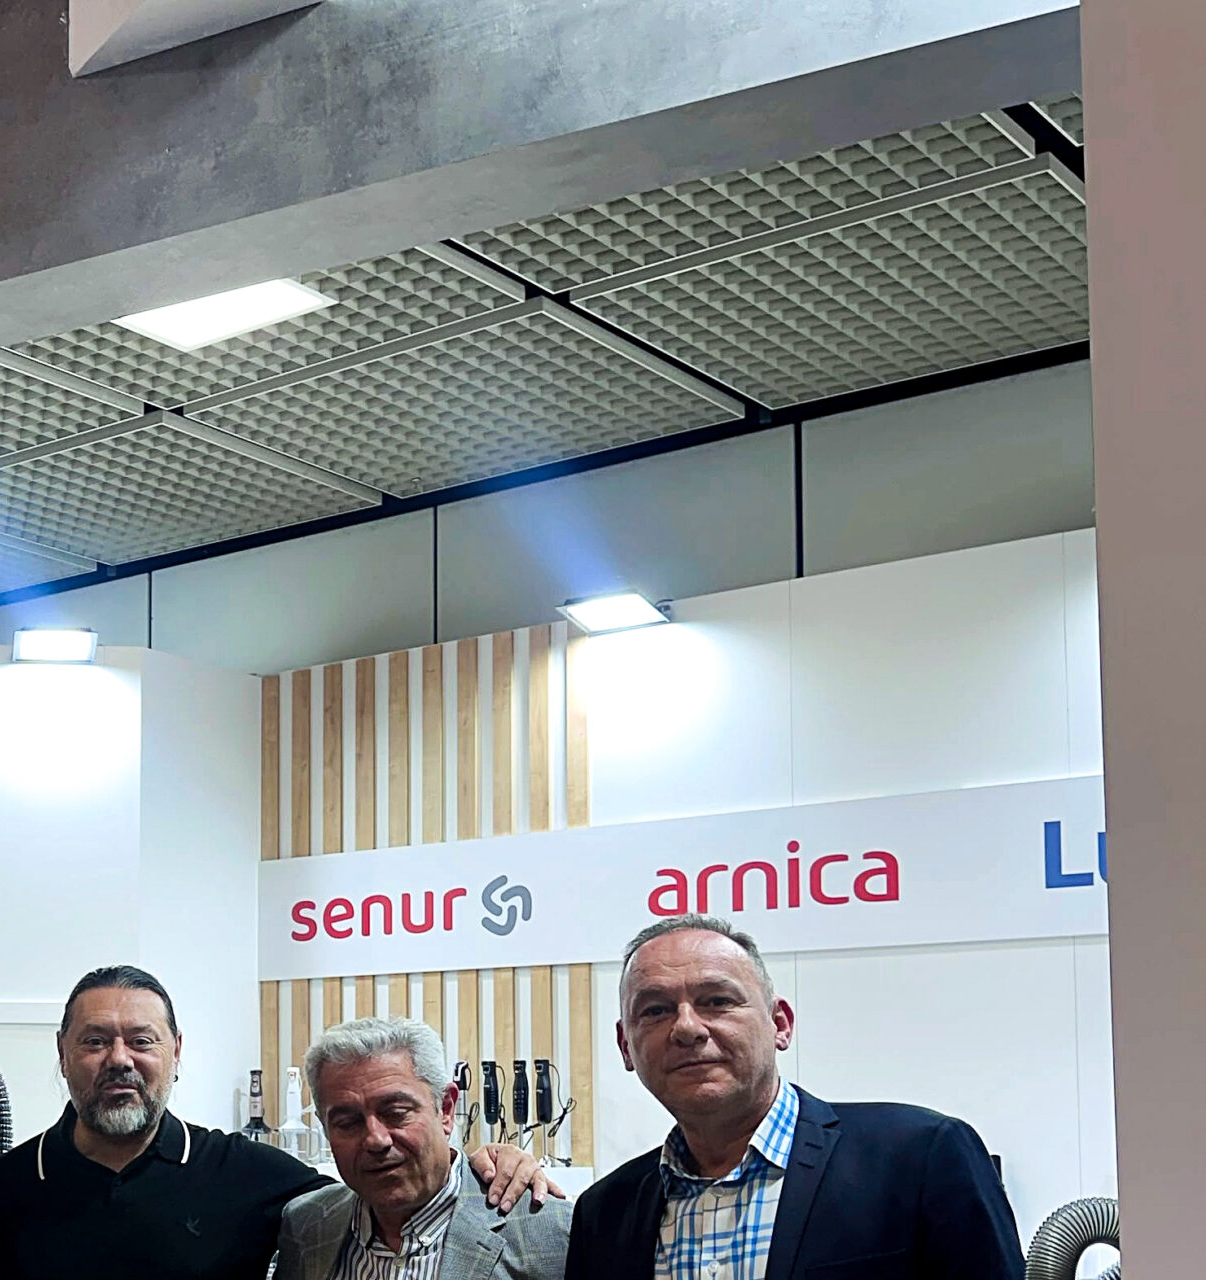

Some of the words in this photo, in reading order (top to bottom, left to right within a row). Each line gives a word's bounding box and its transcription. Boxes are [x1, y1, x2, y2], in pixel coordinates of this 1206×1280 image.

[647, 840, 900, 917] arnica
[1043, 820, 1107, 889] L
[291, 887, 467, 942] senur
